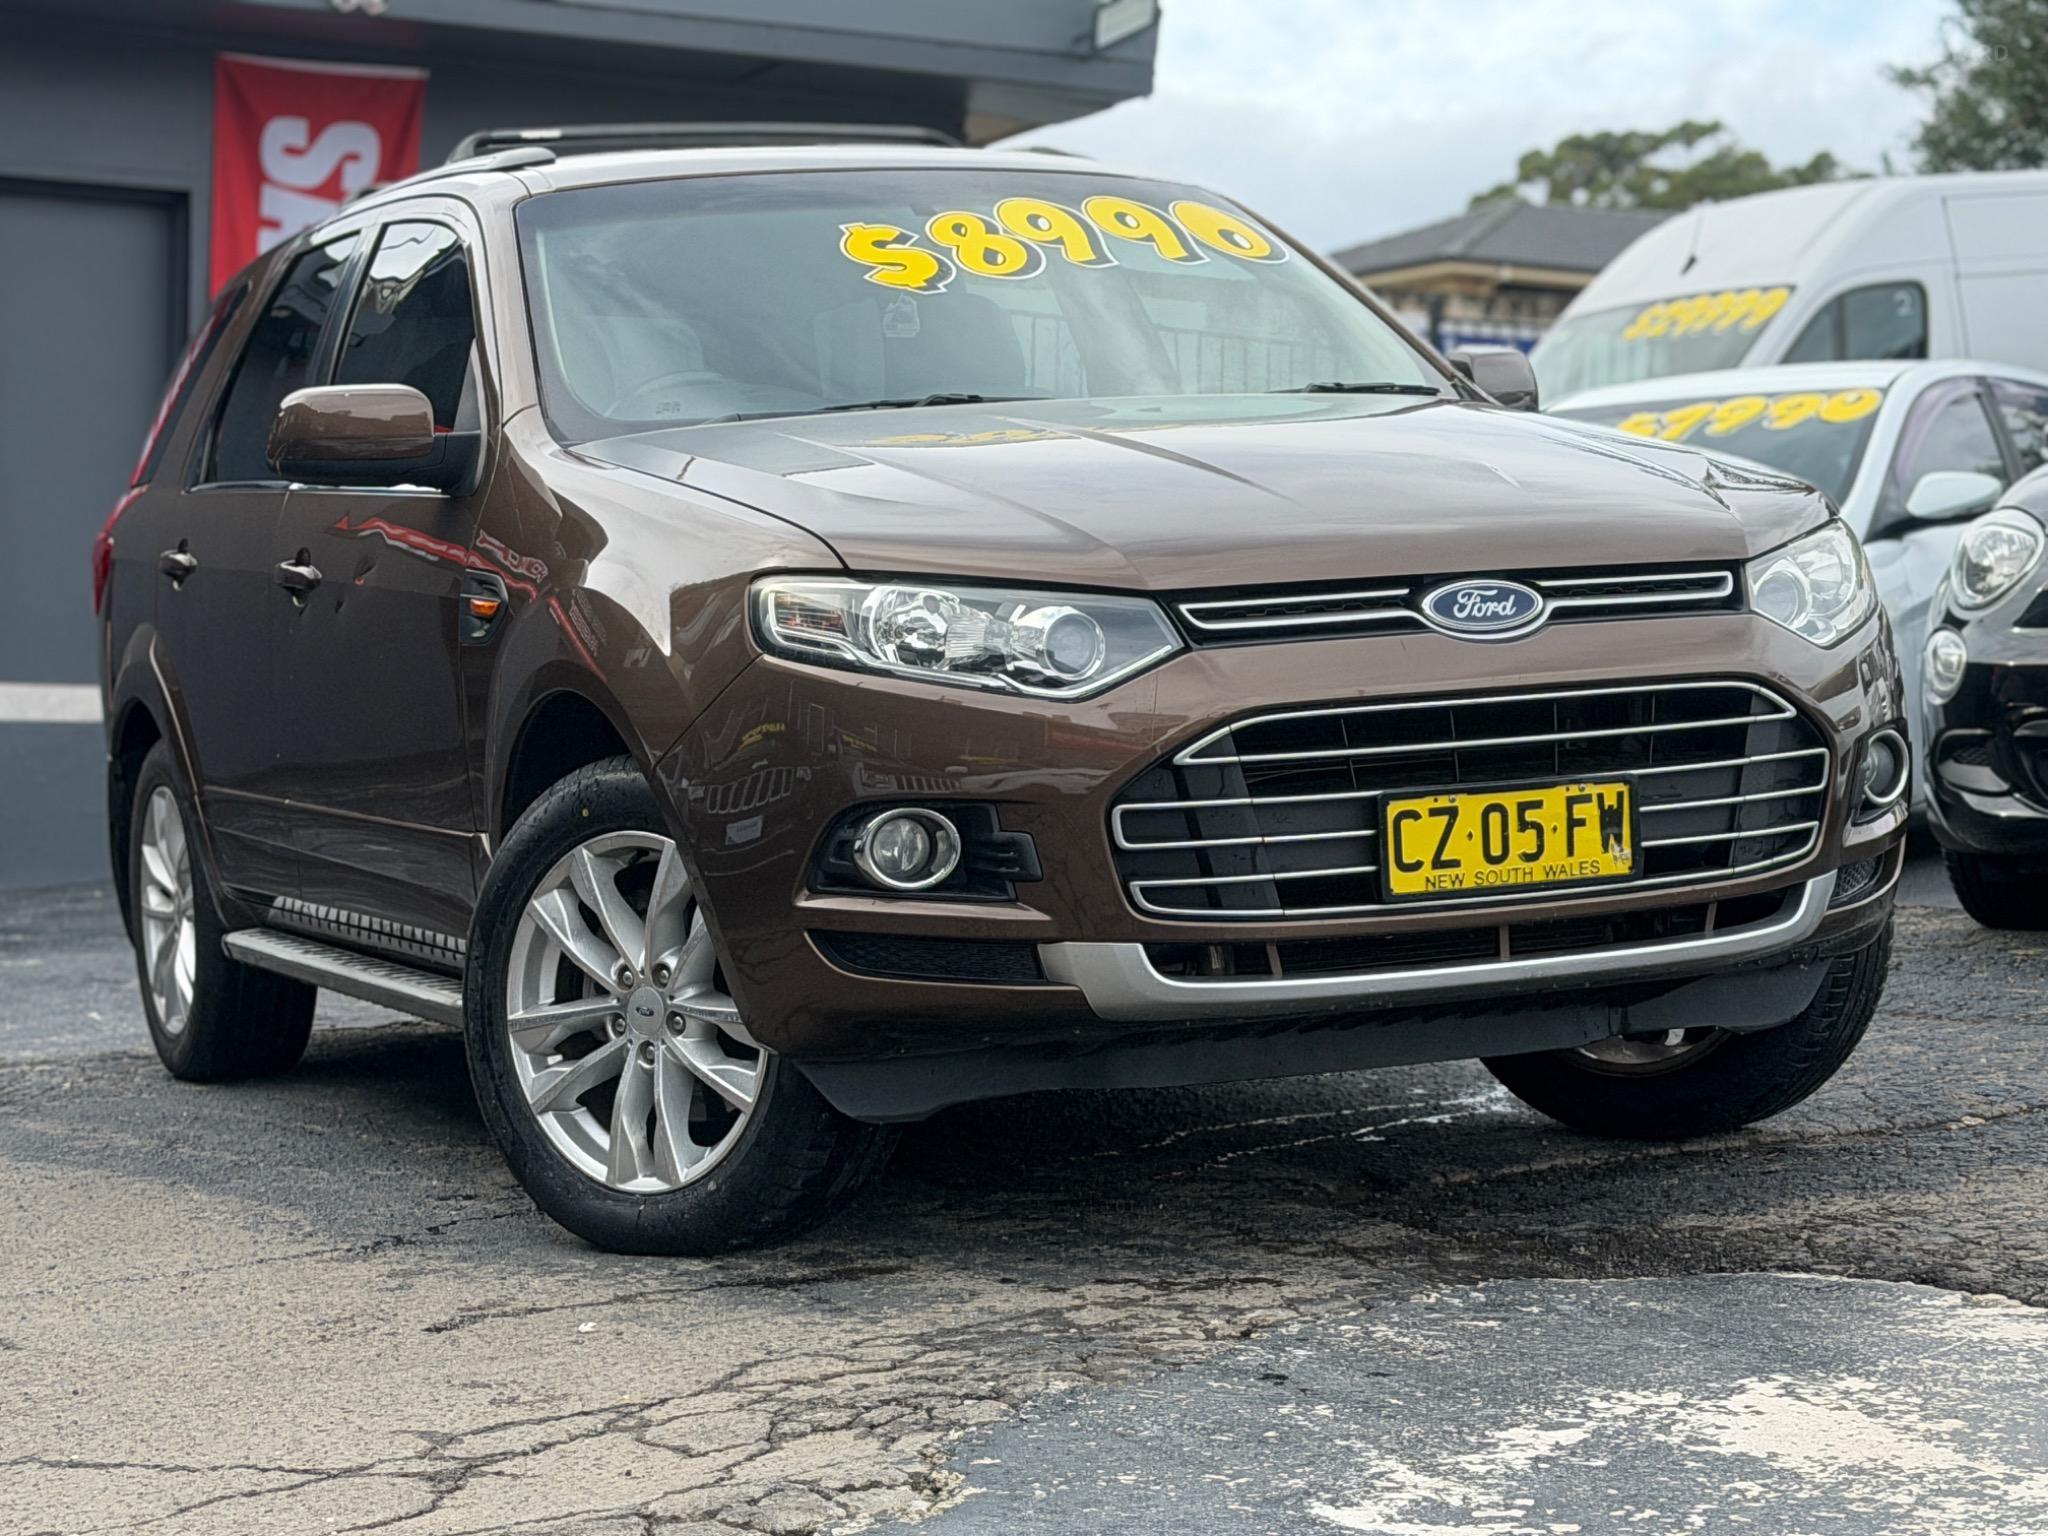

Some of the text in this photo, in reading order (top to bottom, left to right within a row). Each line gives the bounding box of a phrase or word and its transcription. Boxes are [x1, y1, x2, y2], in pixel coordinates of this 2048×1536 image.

[839, 196, 1289, 294] $8990
[1453, 589, 1517, 618] Ford
[1425, 859, 1600, 890] NEW SOUTH WALES
